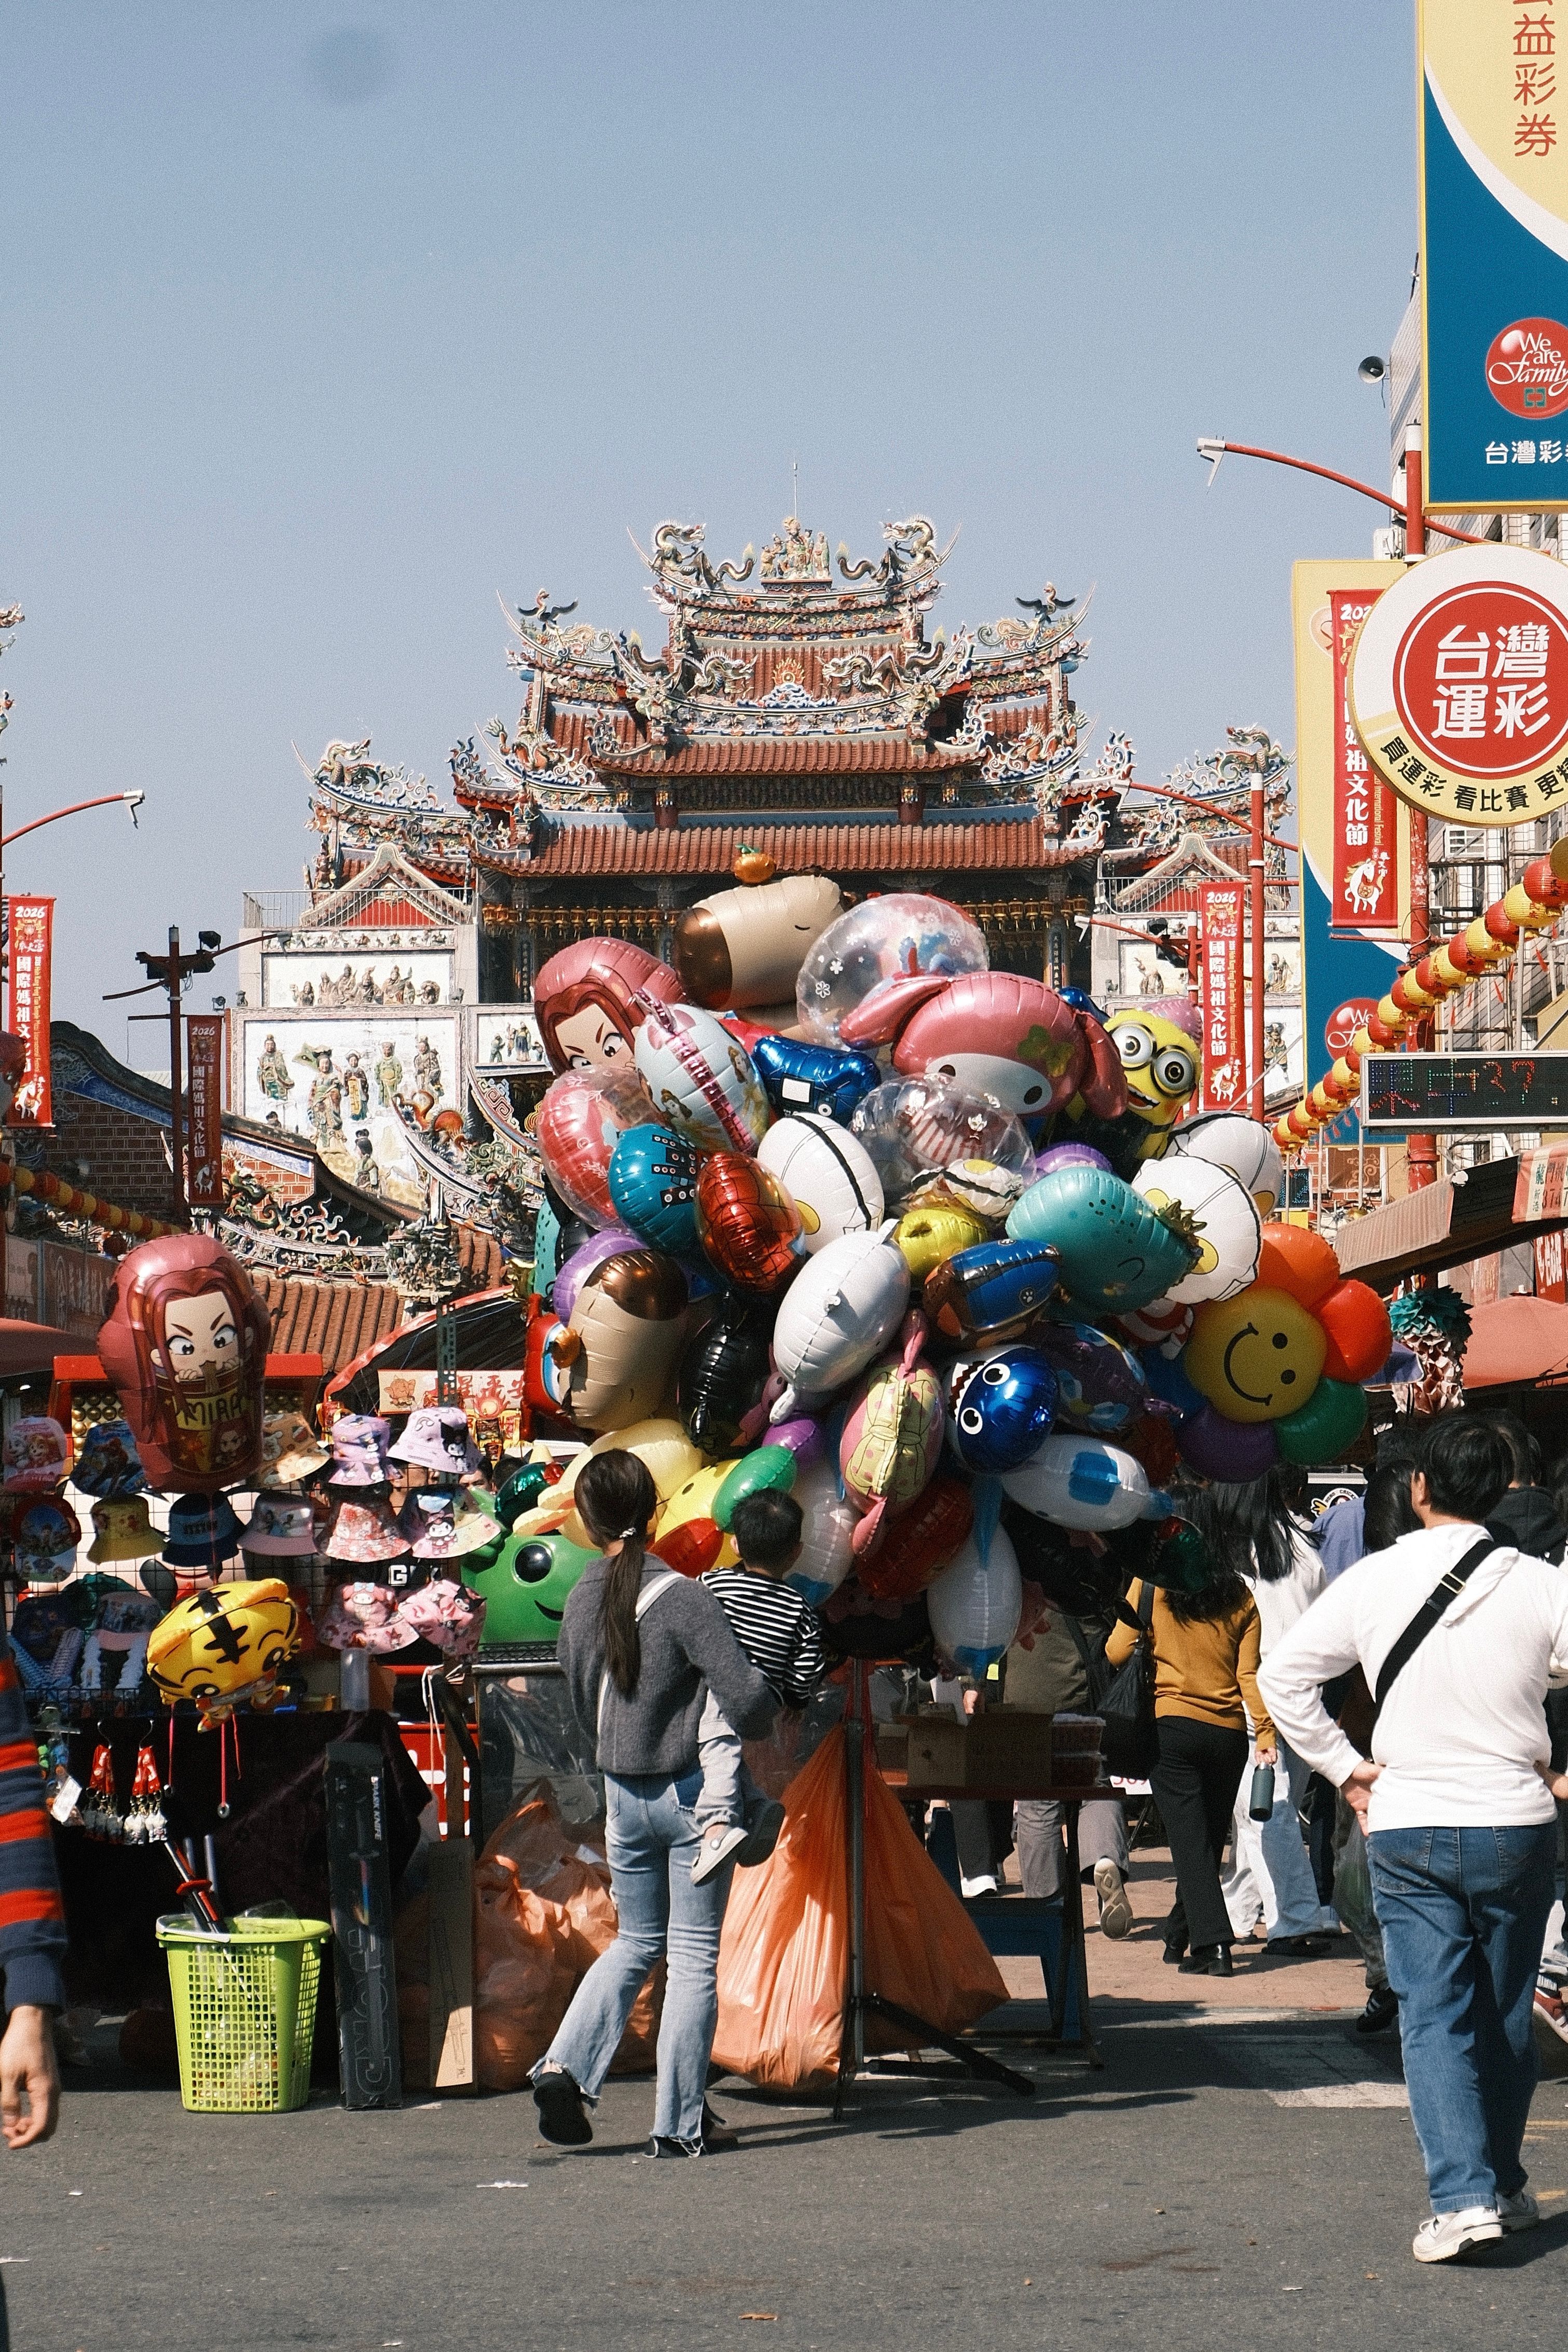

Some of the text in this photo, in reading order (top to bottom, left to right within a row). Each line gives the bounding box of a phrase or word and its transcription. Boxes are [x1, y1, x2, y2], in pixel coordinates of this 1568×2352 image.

[1512, 0, 1557, 157] 益彩券
[1519, 333, 1551, 352] We
[1485, 441, 1568, 464] 台灣彩
[1341, 603, 1374, 621] 202
[1435, 622, 1550, 679] 台灣
[1431, 682, 1551, 738] 運彩
[1381, 736, 1447, 796] 買運彩
[1454, 785, 1530, 811] 看比賽
[1374, 787, 1384, 822] International
[1374, 824, 1384, 846] Festival
[15, 906, 45, 918] 2026
[1206, 891, 1236, 903] 2026
[16, 956, 31, 1072] 國際媽祖文
[1209, 940, 1227, 1056] 國際媽祖文化節
[192, 1027, 215, 1036] 2026
[192, 1066, 205, 1158] 國際媽祖文化節
